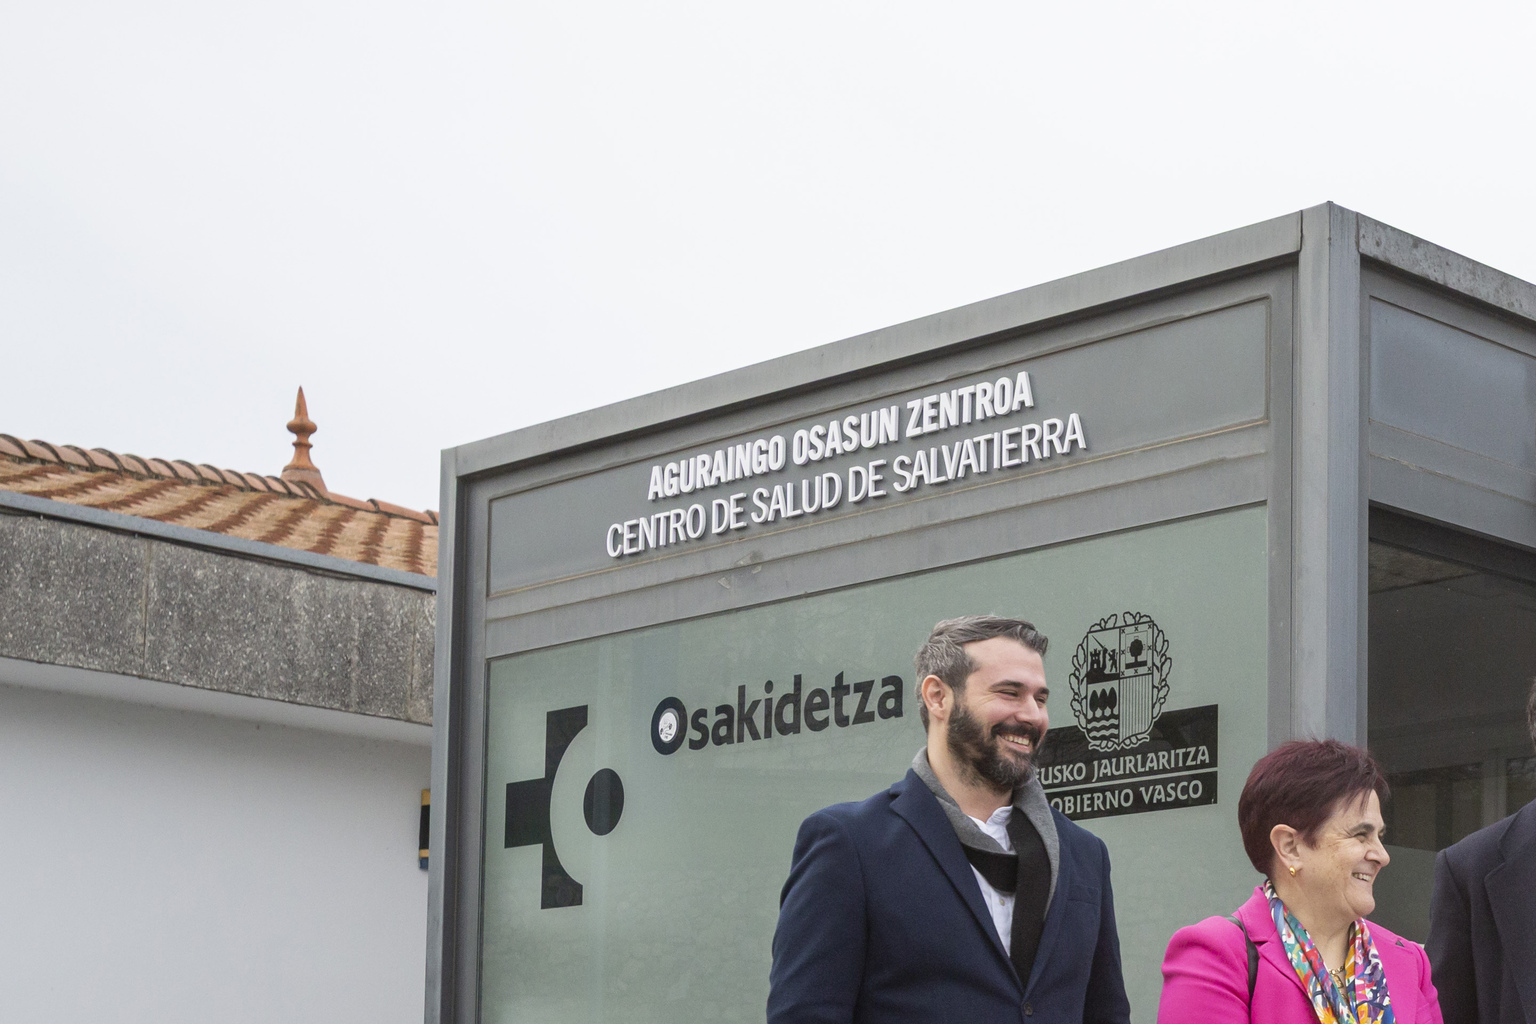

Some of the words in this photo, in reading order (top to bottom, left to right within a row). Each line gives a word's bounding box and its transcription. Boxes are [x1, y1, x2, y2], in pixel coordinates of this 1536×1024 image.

[648, 434, 787, 500] AGURAINGO
[793, 405, 899, 466] OSASUN
[906, 371, 1034, 438] ZENTROA
[606, 503, 706, 558] CENTRO
[712, 493, 747, 534] DE
[751, 472, 843, 523] SALUD
[848, 459, 887, 502] DE
[893, 413, 1087, 493] SALVATIERRA
[651, 671, 904, 756] Osakidetza
[1050, 788, 1134, 815] OBIERNO
[1139, 780, 1203, 805] VASCO
[1092, 746, 1210, 783] JAURLARITZA
